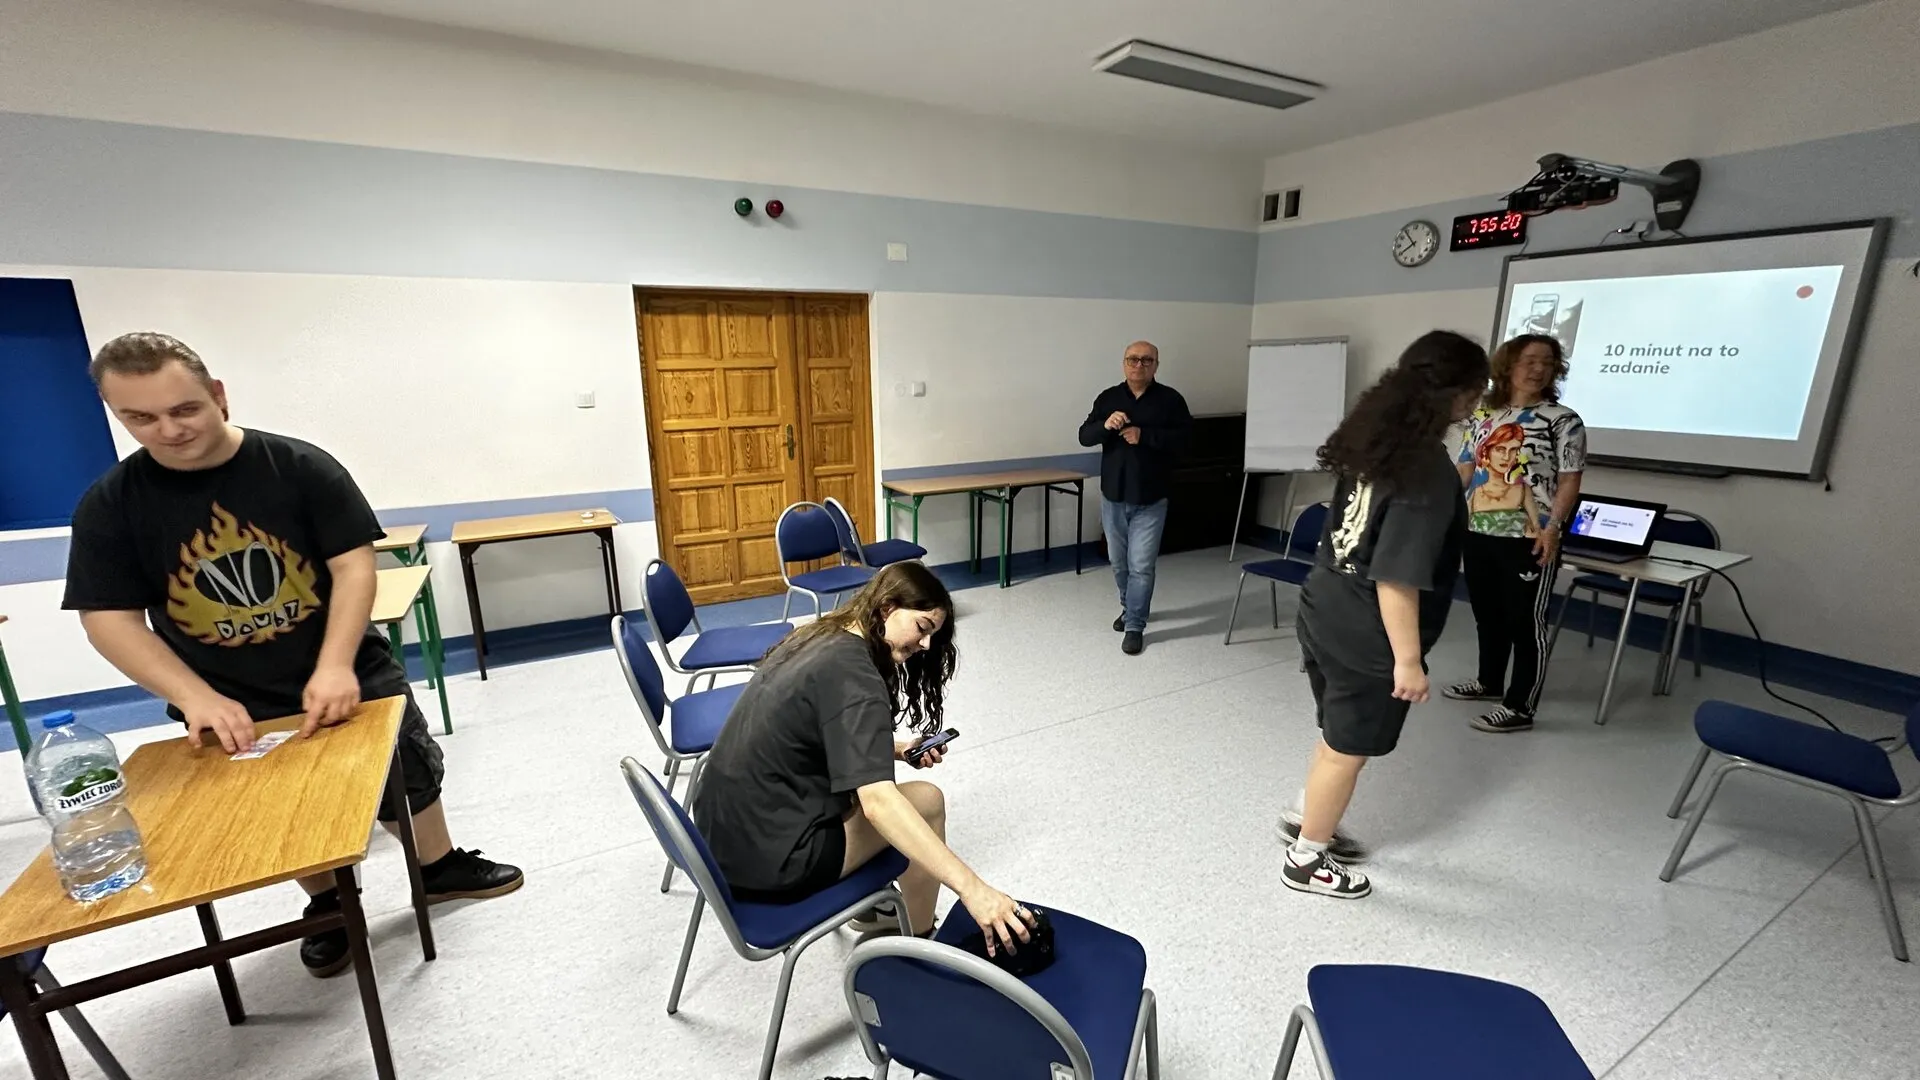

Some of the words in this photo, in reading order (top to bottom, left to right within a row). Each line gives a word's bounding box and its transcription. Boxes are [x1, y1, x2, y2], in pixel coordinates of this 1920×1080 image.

[1604, 344, 1625, 357] 10
[1629, 343, 1683, 357] minut
[1688, 346, 1713, 357] na
[1719, 344, 1740, 357] to
[1599, 360, 1670, 374] zadanie
[198, 541, 280, 614] NO
[97, 779, 124, 795] ZDR
